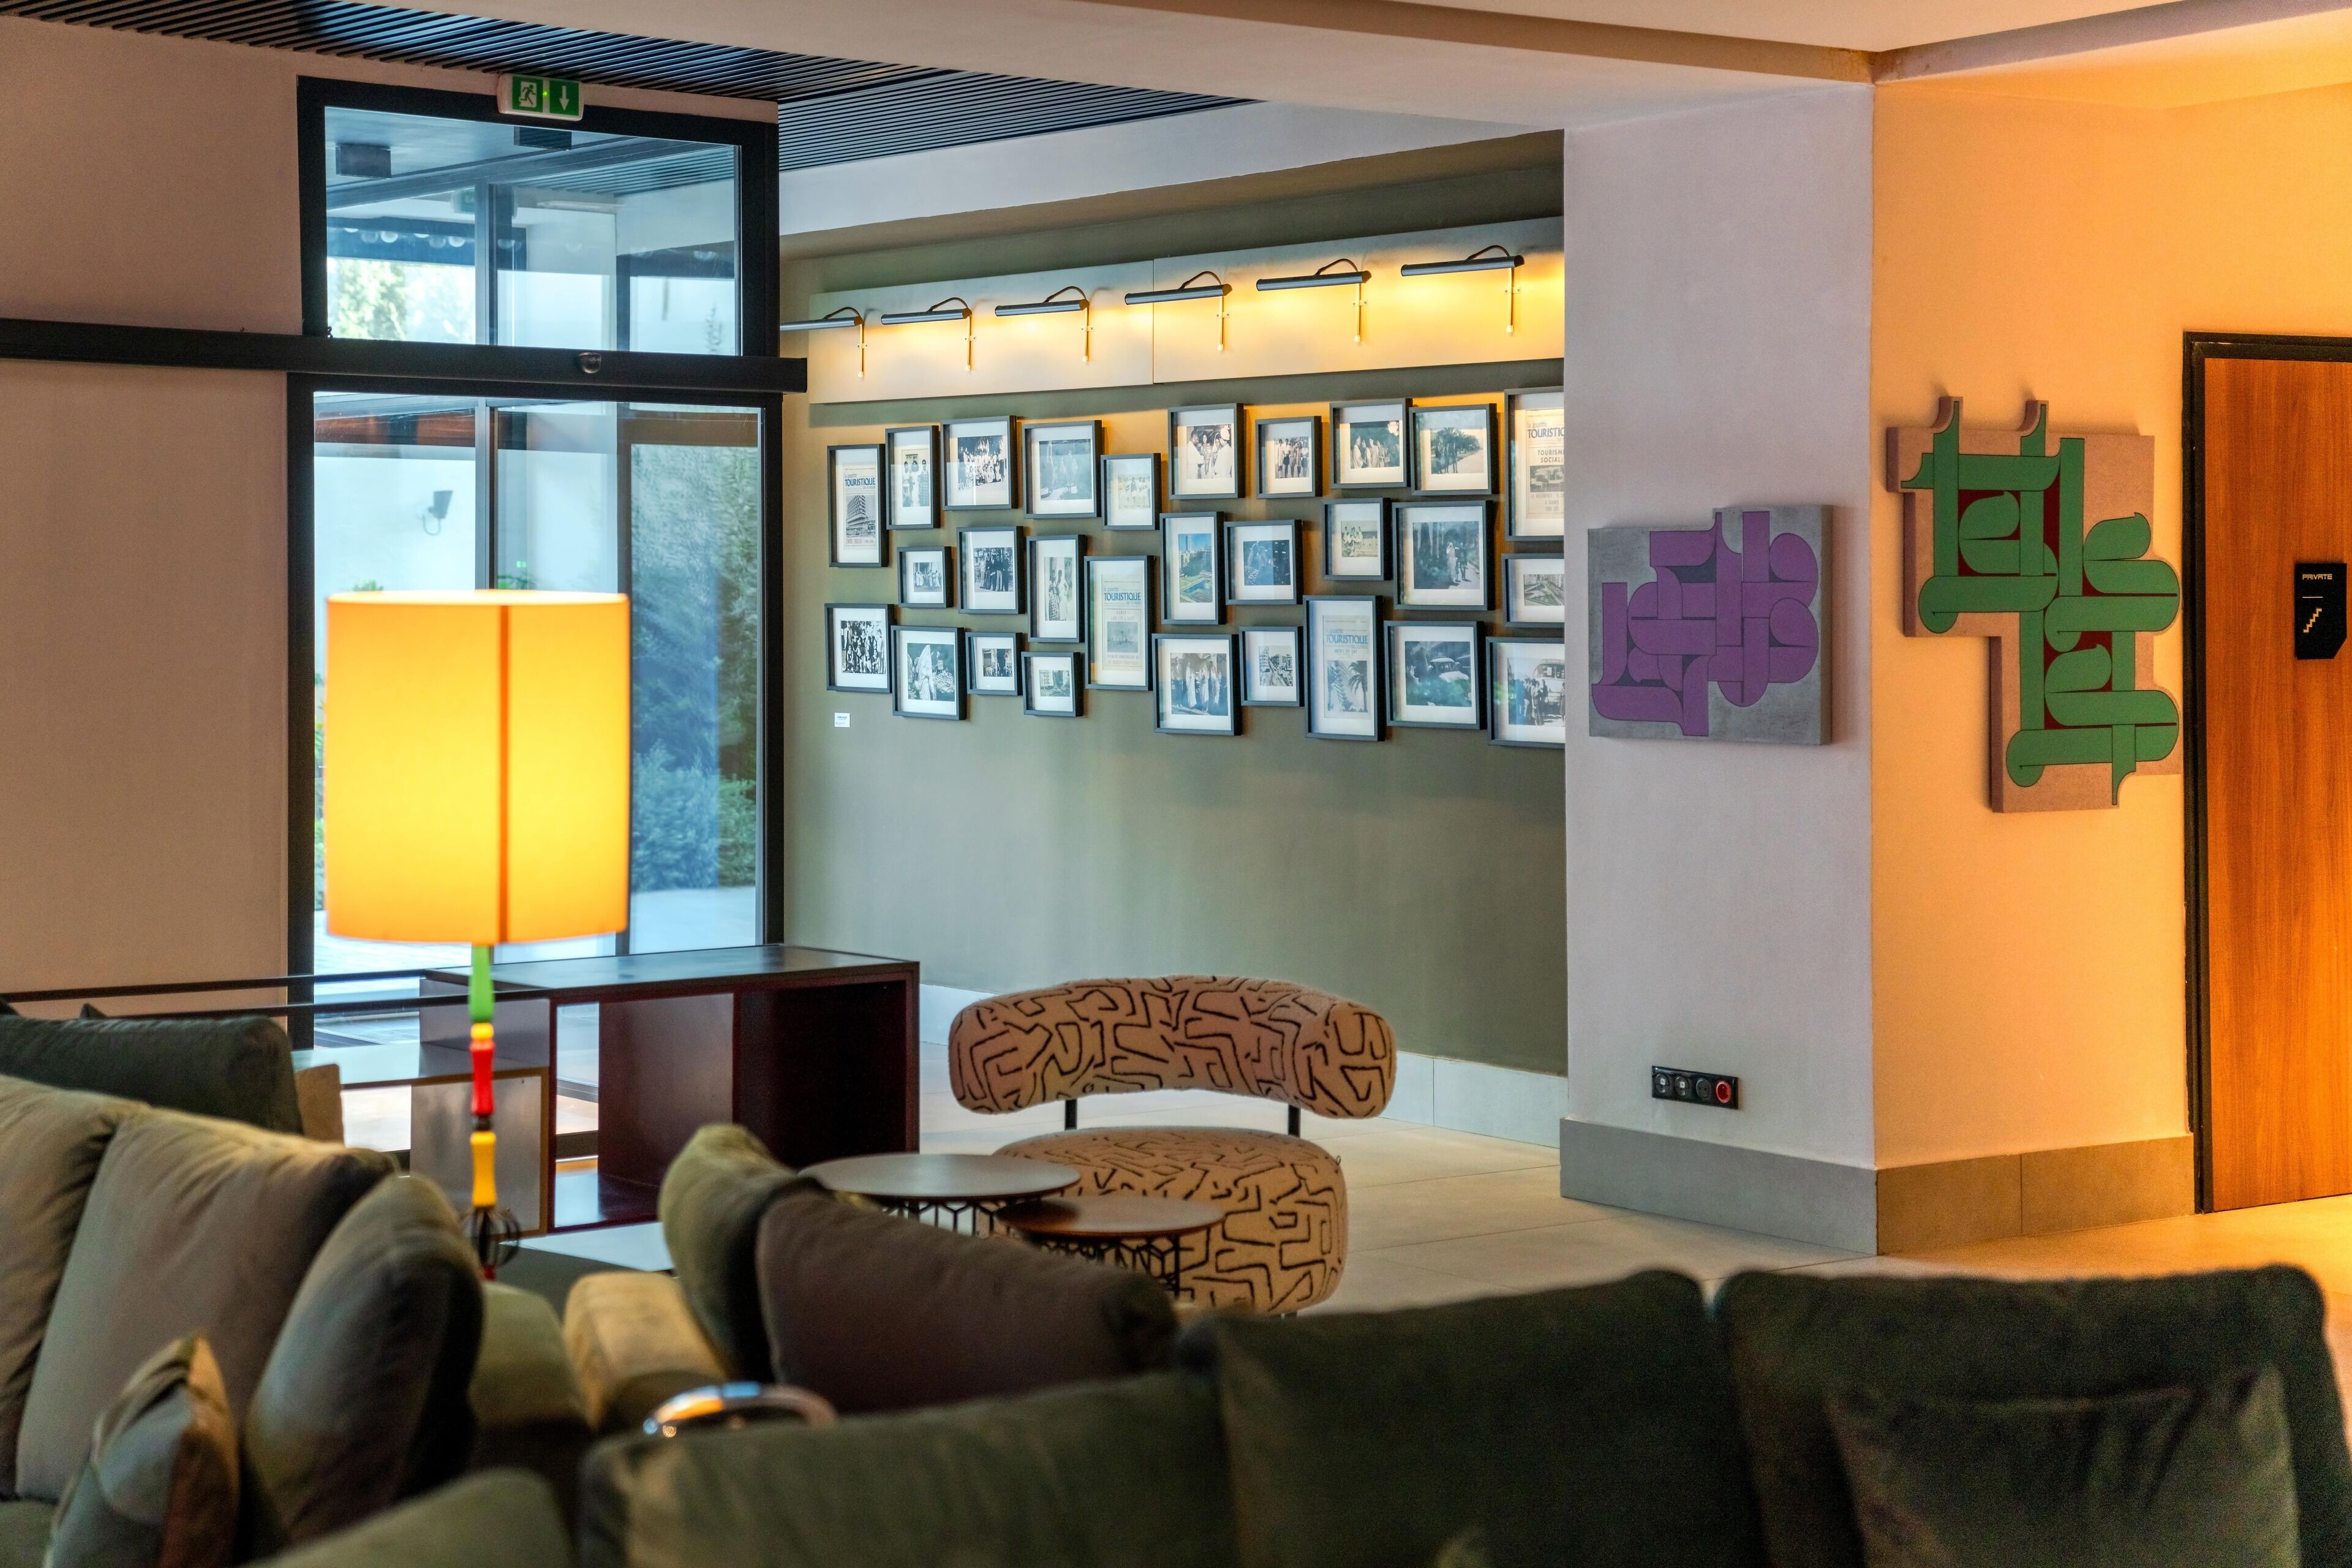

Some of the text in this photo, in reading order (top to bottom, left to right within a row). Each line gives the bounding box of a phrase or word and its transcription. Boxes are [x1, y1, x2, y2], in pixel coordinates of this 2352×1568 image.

[845, 477, 875, 487] TOURISTIQUE
[1104, 592, 1141, 601] TOURISTIQUE
[1326, 634, 1368, 644] TOURISTIQUE
